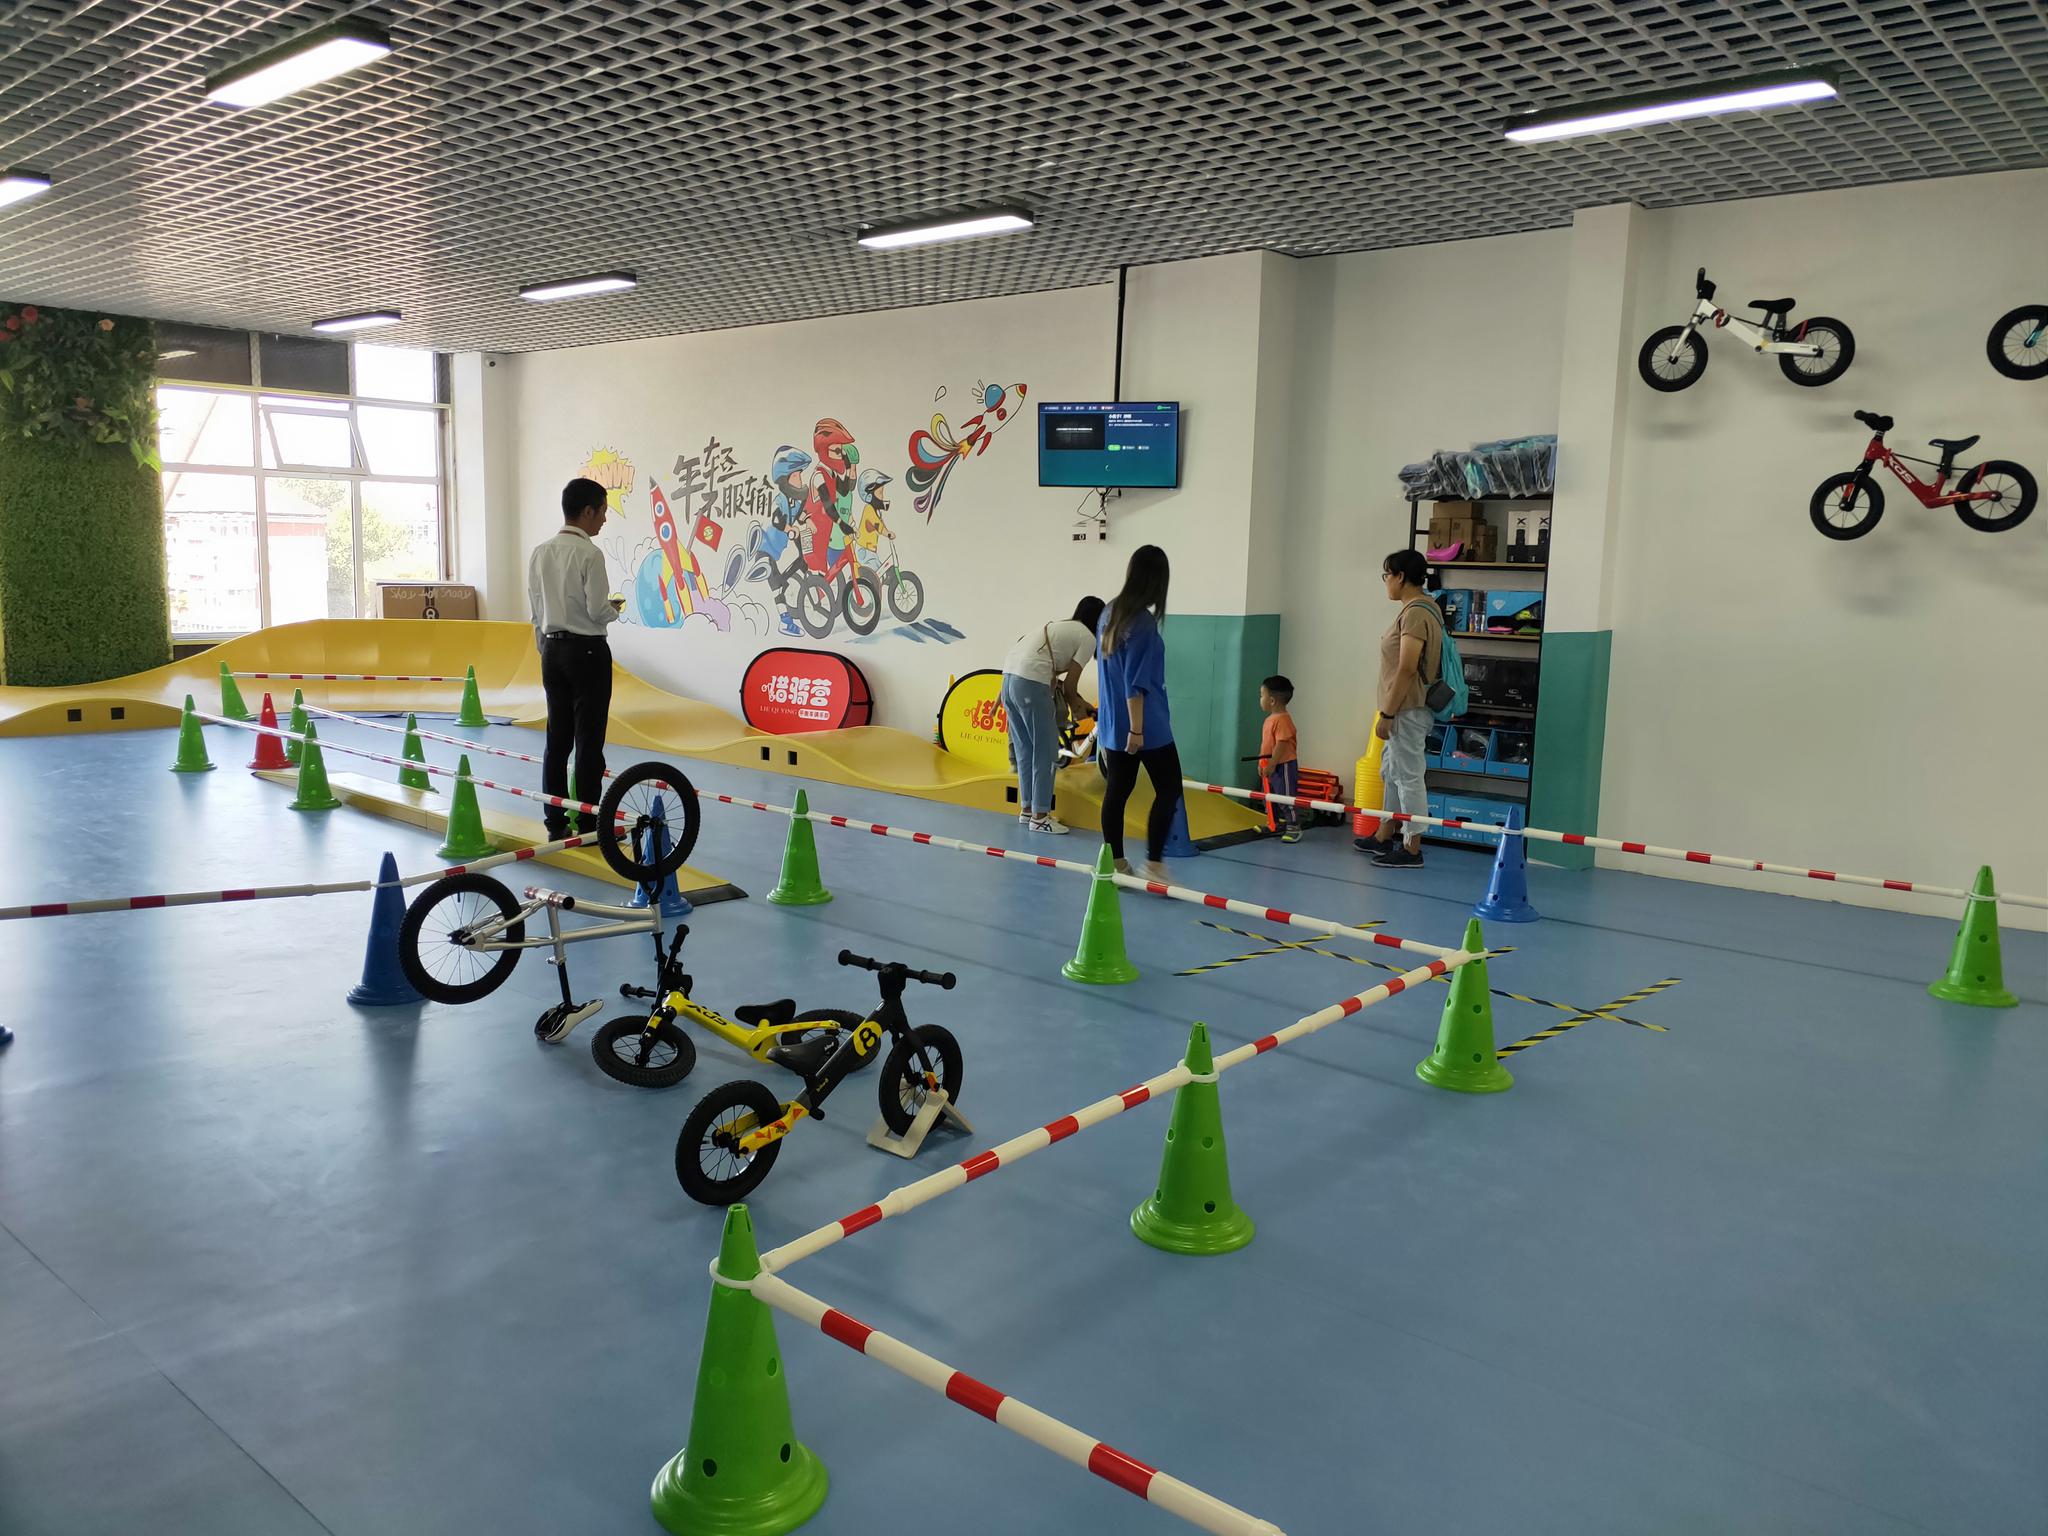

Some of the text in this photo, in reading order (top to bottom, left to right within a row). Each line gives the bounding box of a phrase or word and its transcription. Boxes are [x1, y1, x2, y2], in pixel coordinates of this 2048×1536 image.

[671, 436, 749, 524] 年轻
[694, 474, 774, 519] 不服输
